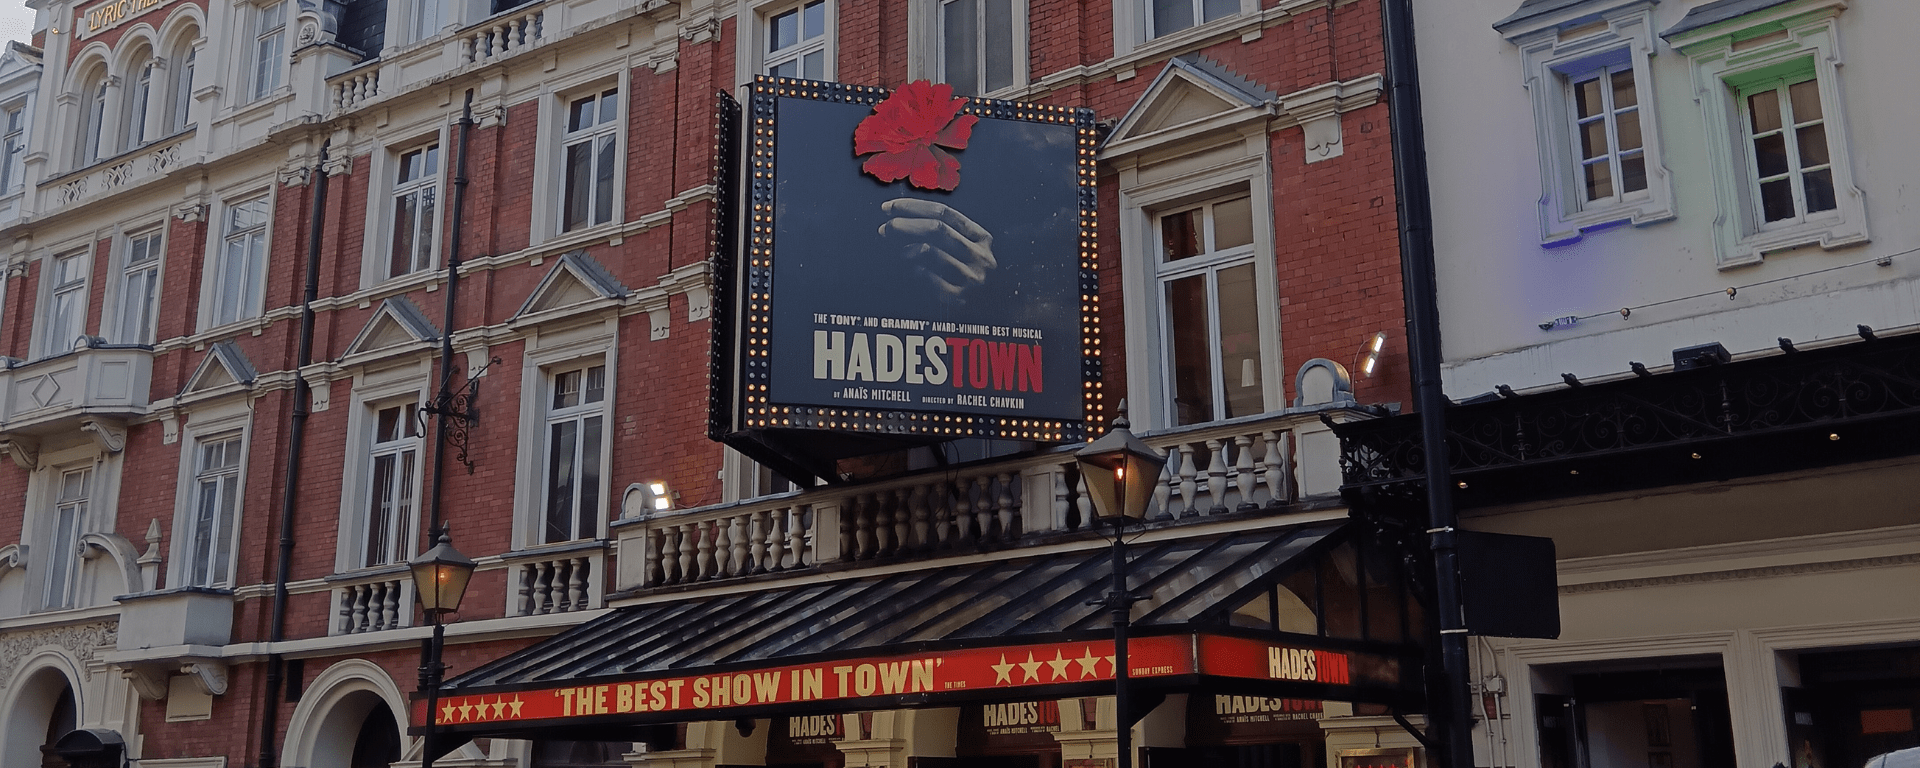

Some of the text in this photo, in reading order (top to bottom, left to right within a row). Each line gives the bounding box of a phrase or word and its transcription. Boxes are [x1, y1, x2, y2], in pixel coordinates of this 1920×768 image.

[90, 0, 126, 31] LYRIC
[813, 313, 828, 324] THE
[863, 316, 878, 327] AND
[932, 321, 990, 335] AWARD-WINNING
[992, 325, 1010, 337] BEST
[1012, 327, 1043, 340] MUSICAL
[813, 330, 1043, 393] HADESTOWN
[871, 389, 911, 402] MITCHELL
[922, 396, 946, 404] DIRECTED
[957, 394, 988, 407] RACHEL
[990, 396, 1024, 409] CHAVKIN
[1151, 665, 1173, 675] EXPRESS
[1268, 647, 1349, 684] HADESTOWN
[616, 680, 685, 713] BEST
[692, 671, 782, 708] SHOW
[791, 668, 823, 700] IN
